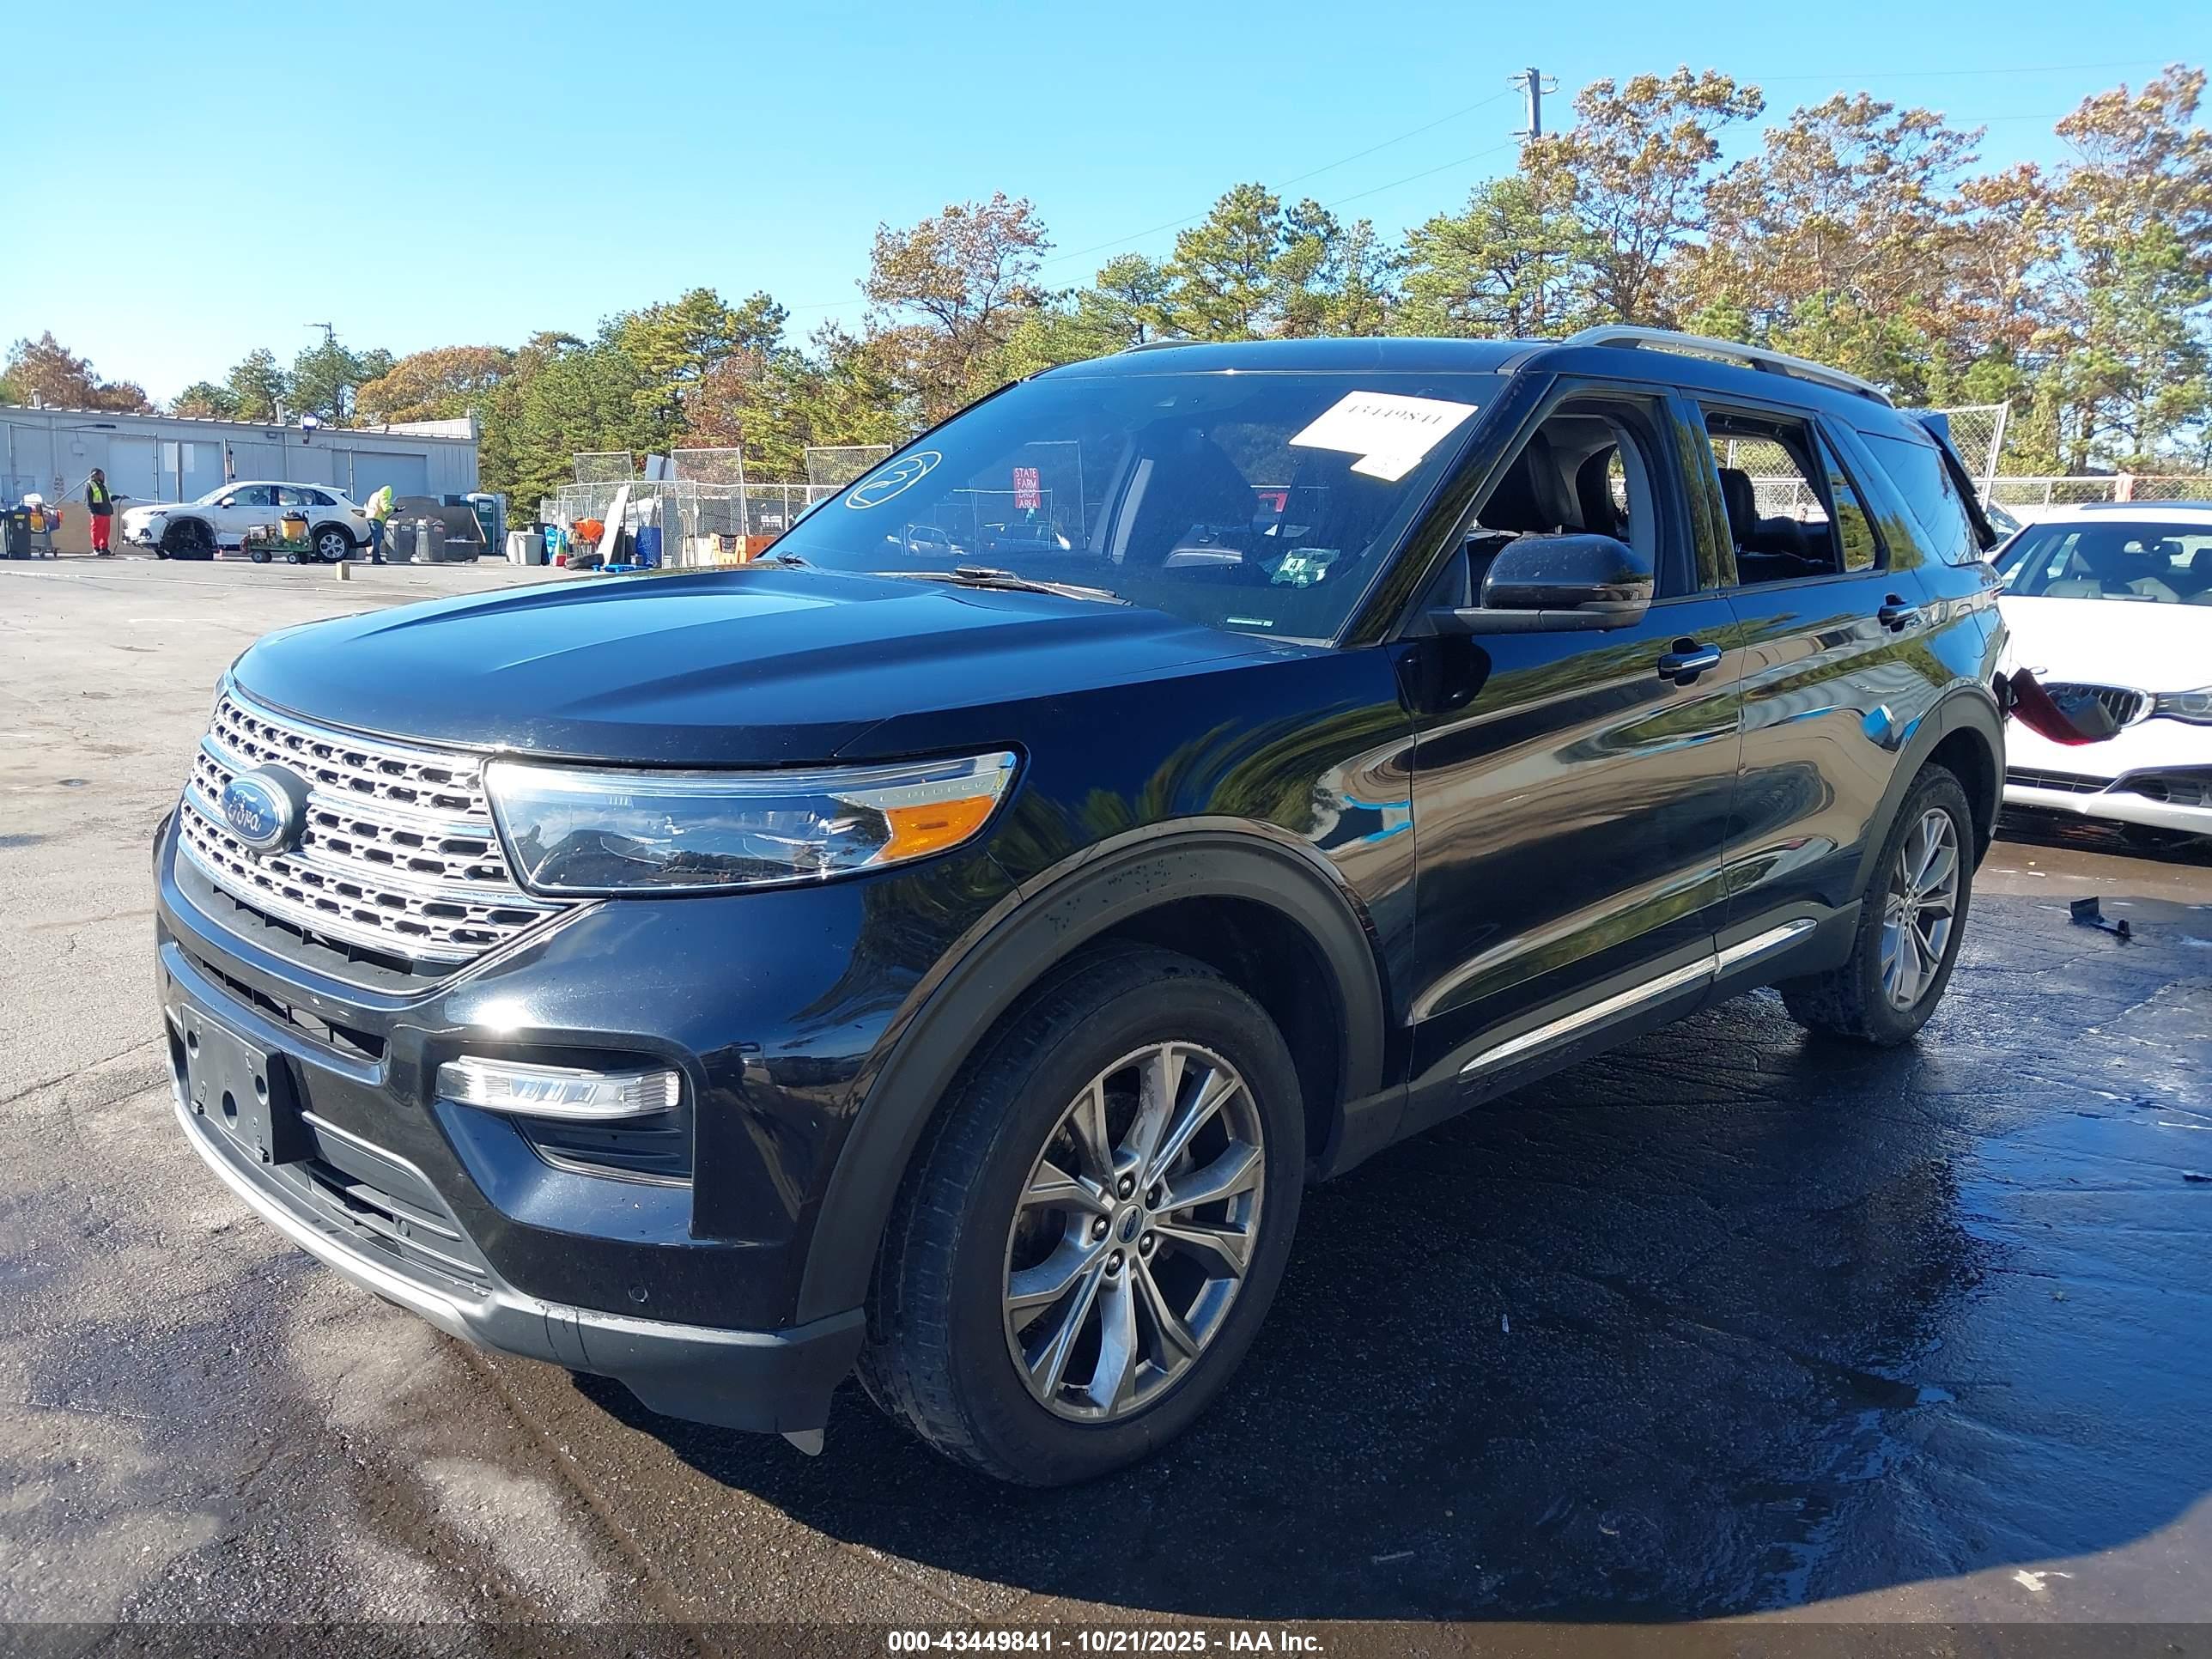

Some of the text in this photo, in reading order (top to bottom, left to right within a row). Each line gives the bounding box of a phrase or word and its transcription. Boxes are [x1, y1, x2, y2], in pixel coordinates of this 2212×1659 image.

[1015, 467, 1037, 478] STATE
[1017, 478, 1037, 489] FARM
[1018, 489, 1036, 499] DROP
[1018, 499, 1038, 509] AREA
[228, 789, 262, 832] Ford
